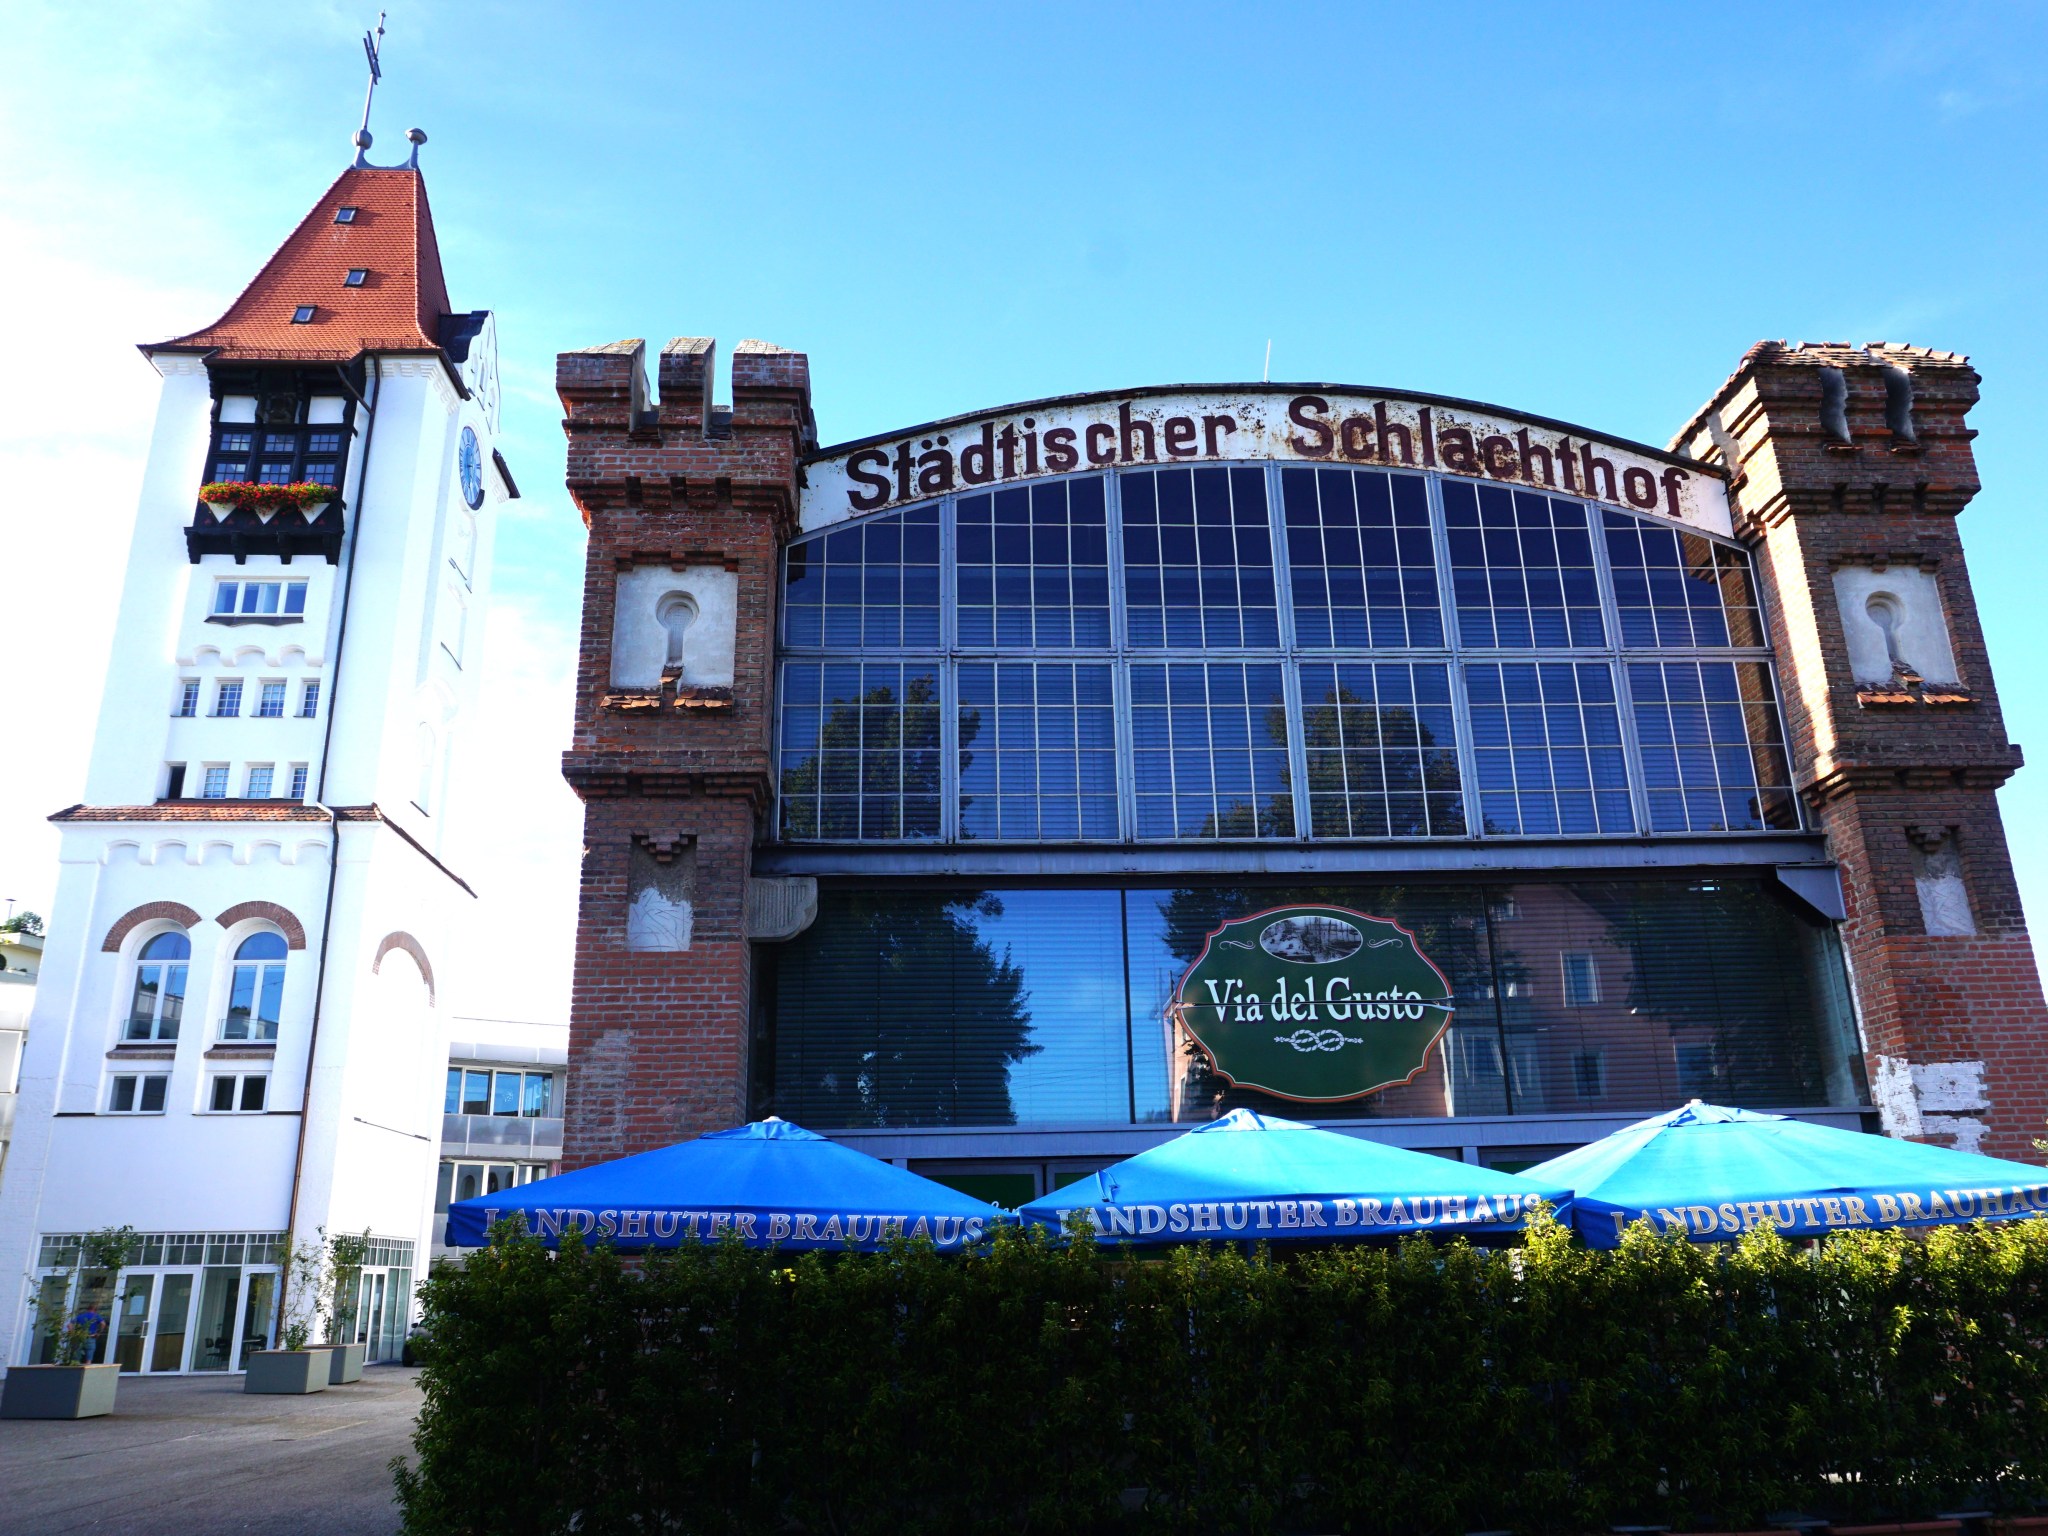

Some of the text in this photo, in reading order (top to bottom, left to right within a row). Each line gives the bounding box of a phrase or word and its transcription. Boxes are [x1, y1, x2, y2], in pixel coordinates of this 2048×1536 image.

[846, 395, 1690, 518] Städtischer Schlachthof
[1204, 976, 1425, 1023] Via del Gusto
[766, 1213, 984, 1245] BRAUHAUS
